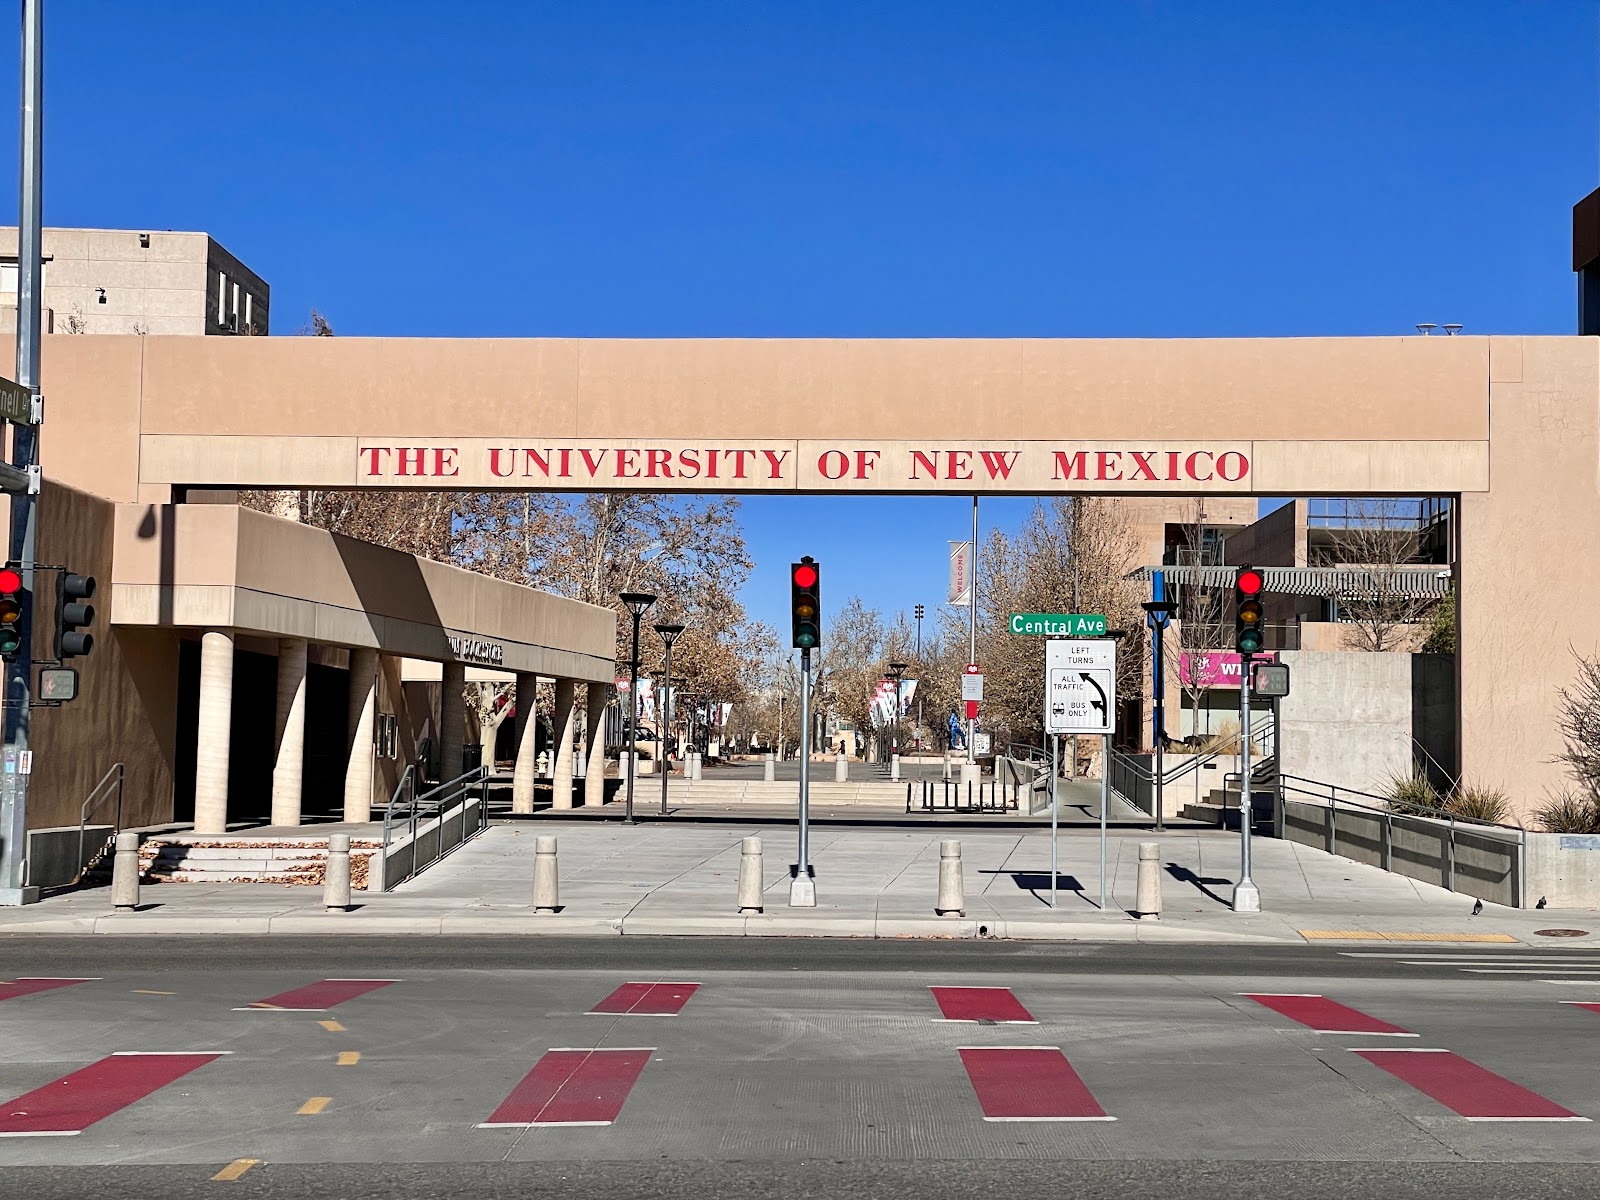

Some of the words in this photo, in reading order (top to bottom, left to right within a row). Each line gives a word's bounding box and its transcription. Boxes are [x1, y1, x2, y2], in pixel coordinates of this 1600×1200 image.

[0, 389, 19, 416] nell
[360, 447, 459, 477] THE
[487, 448, 792, 480] UNIVERSITY
[817, 450, 881, 480] OF
[908, 450, 1021, 481] NEW
[1051, 450, 1249, 482] MEXICO
[1012, 615, 1071, 633] Central
[1077, 618, 1104, 631] Ave
[1053, 683, 1084, 691] TRAFFIC
